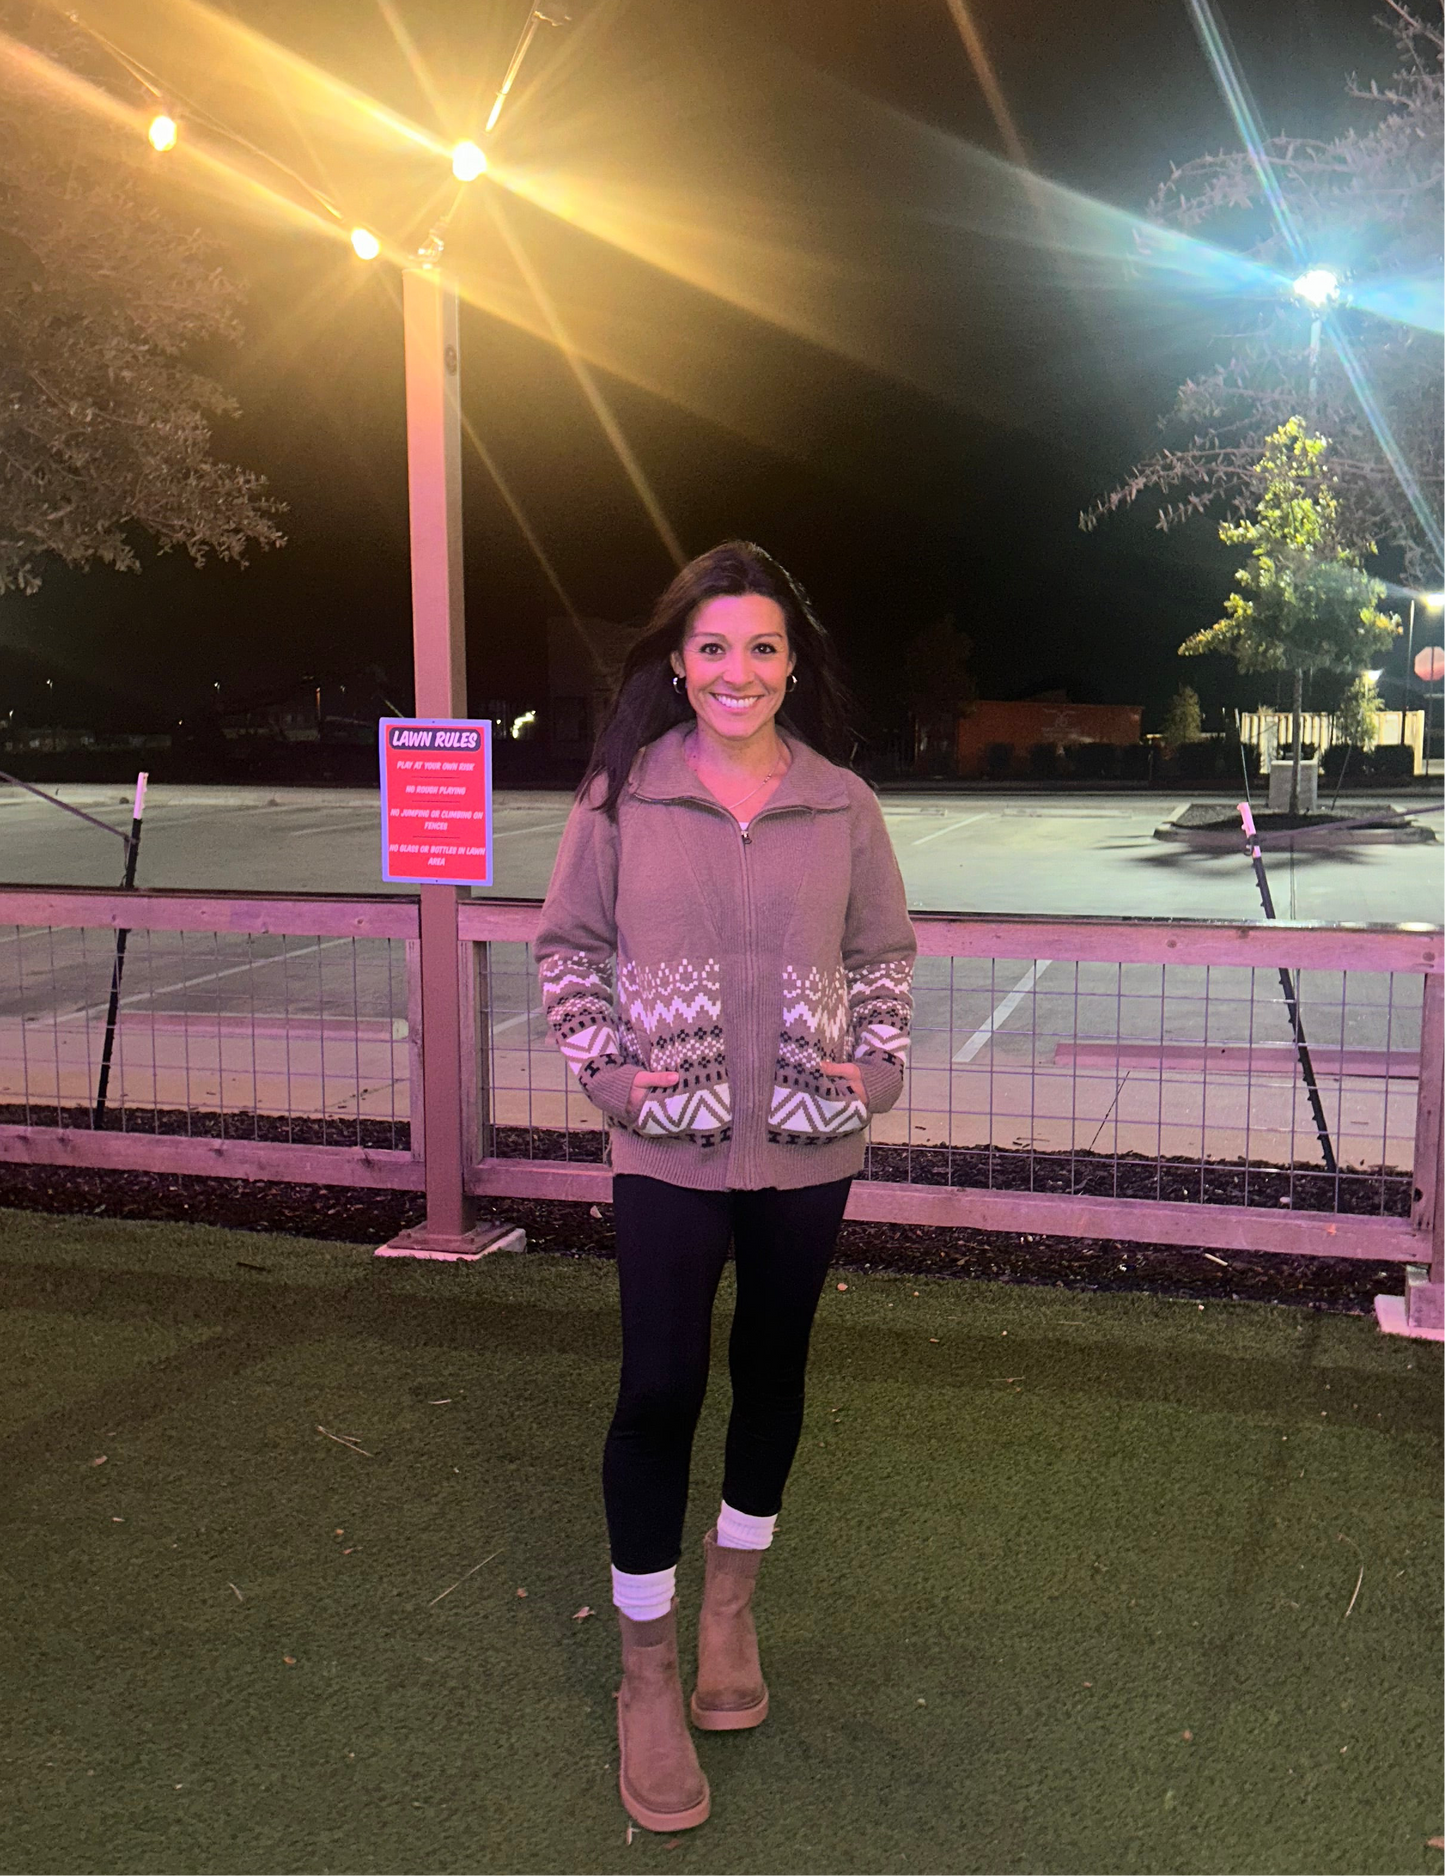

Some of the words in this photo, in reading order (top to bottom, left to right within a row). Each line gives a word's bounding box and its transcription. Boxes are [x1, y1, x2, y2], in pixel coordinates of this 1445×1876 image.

[392, 731, 432, 747] LAWN
[435, 731, 477, 748] RULES
[397, 761, 412, 769] PLAY
[413, 761, 422, 770] AT
[424, 762, 441, 770] YOUR
[459, 763, 475, 771] RISK
[417, 786, 437, 794] ROUGH
[439, 787, 465, 795] PLAYING
[401, 809, 429, 818] JUMPING
[430, 810, 439, 818] OR
[441, 810, 472, 818] CLIMBING
[424, 822, 448, 830] FENCES
[389, 844, 398, 852] NO
[400, 845, 419, 853] GLASS
[430, 846, 457, 854] BOTTLES
[466, 847, 485, 855] LAWN
[428, 858, 445, 866] AREA
